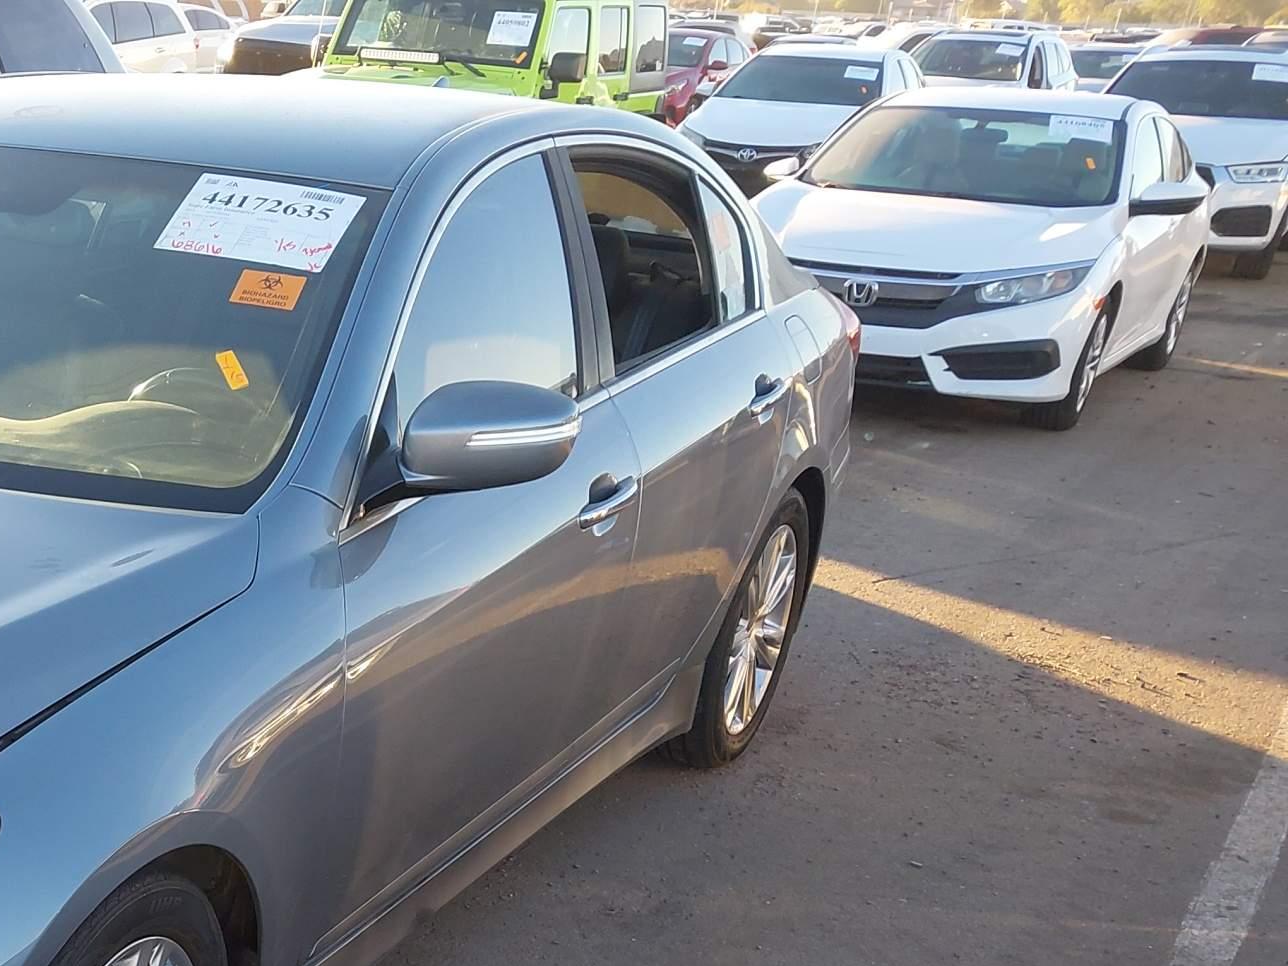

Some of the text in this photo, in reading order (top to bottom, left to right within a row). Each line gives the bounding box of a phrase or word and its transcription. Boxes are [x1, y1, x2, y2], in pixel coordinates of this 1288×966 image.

[202, 191, 334, 221] 44172635
[238, 295, 287, 307] BIOPELIGRO
[242, 289, 289, 301] BIOHAZARD
